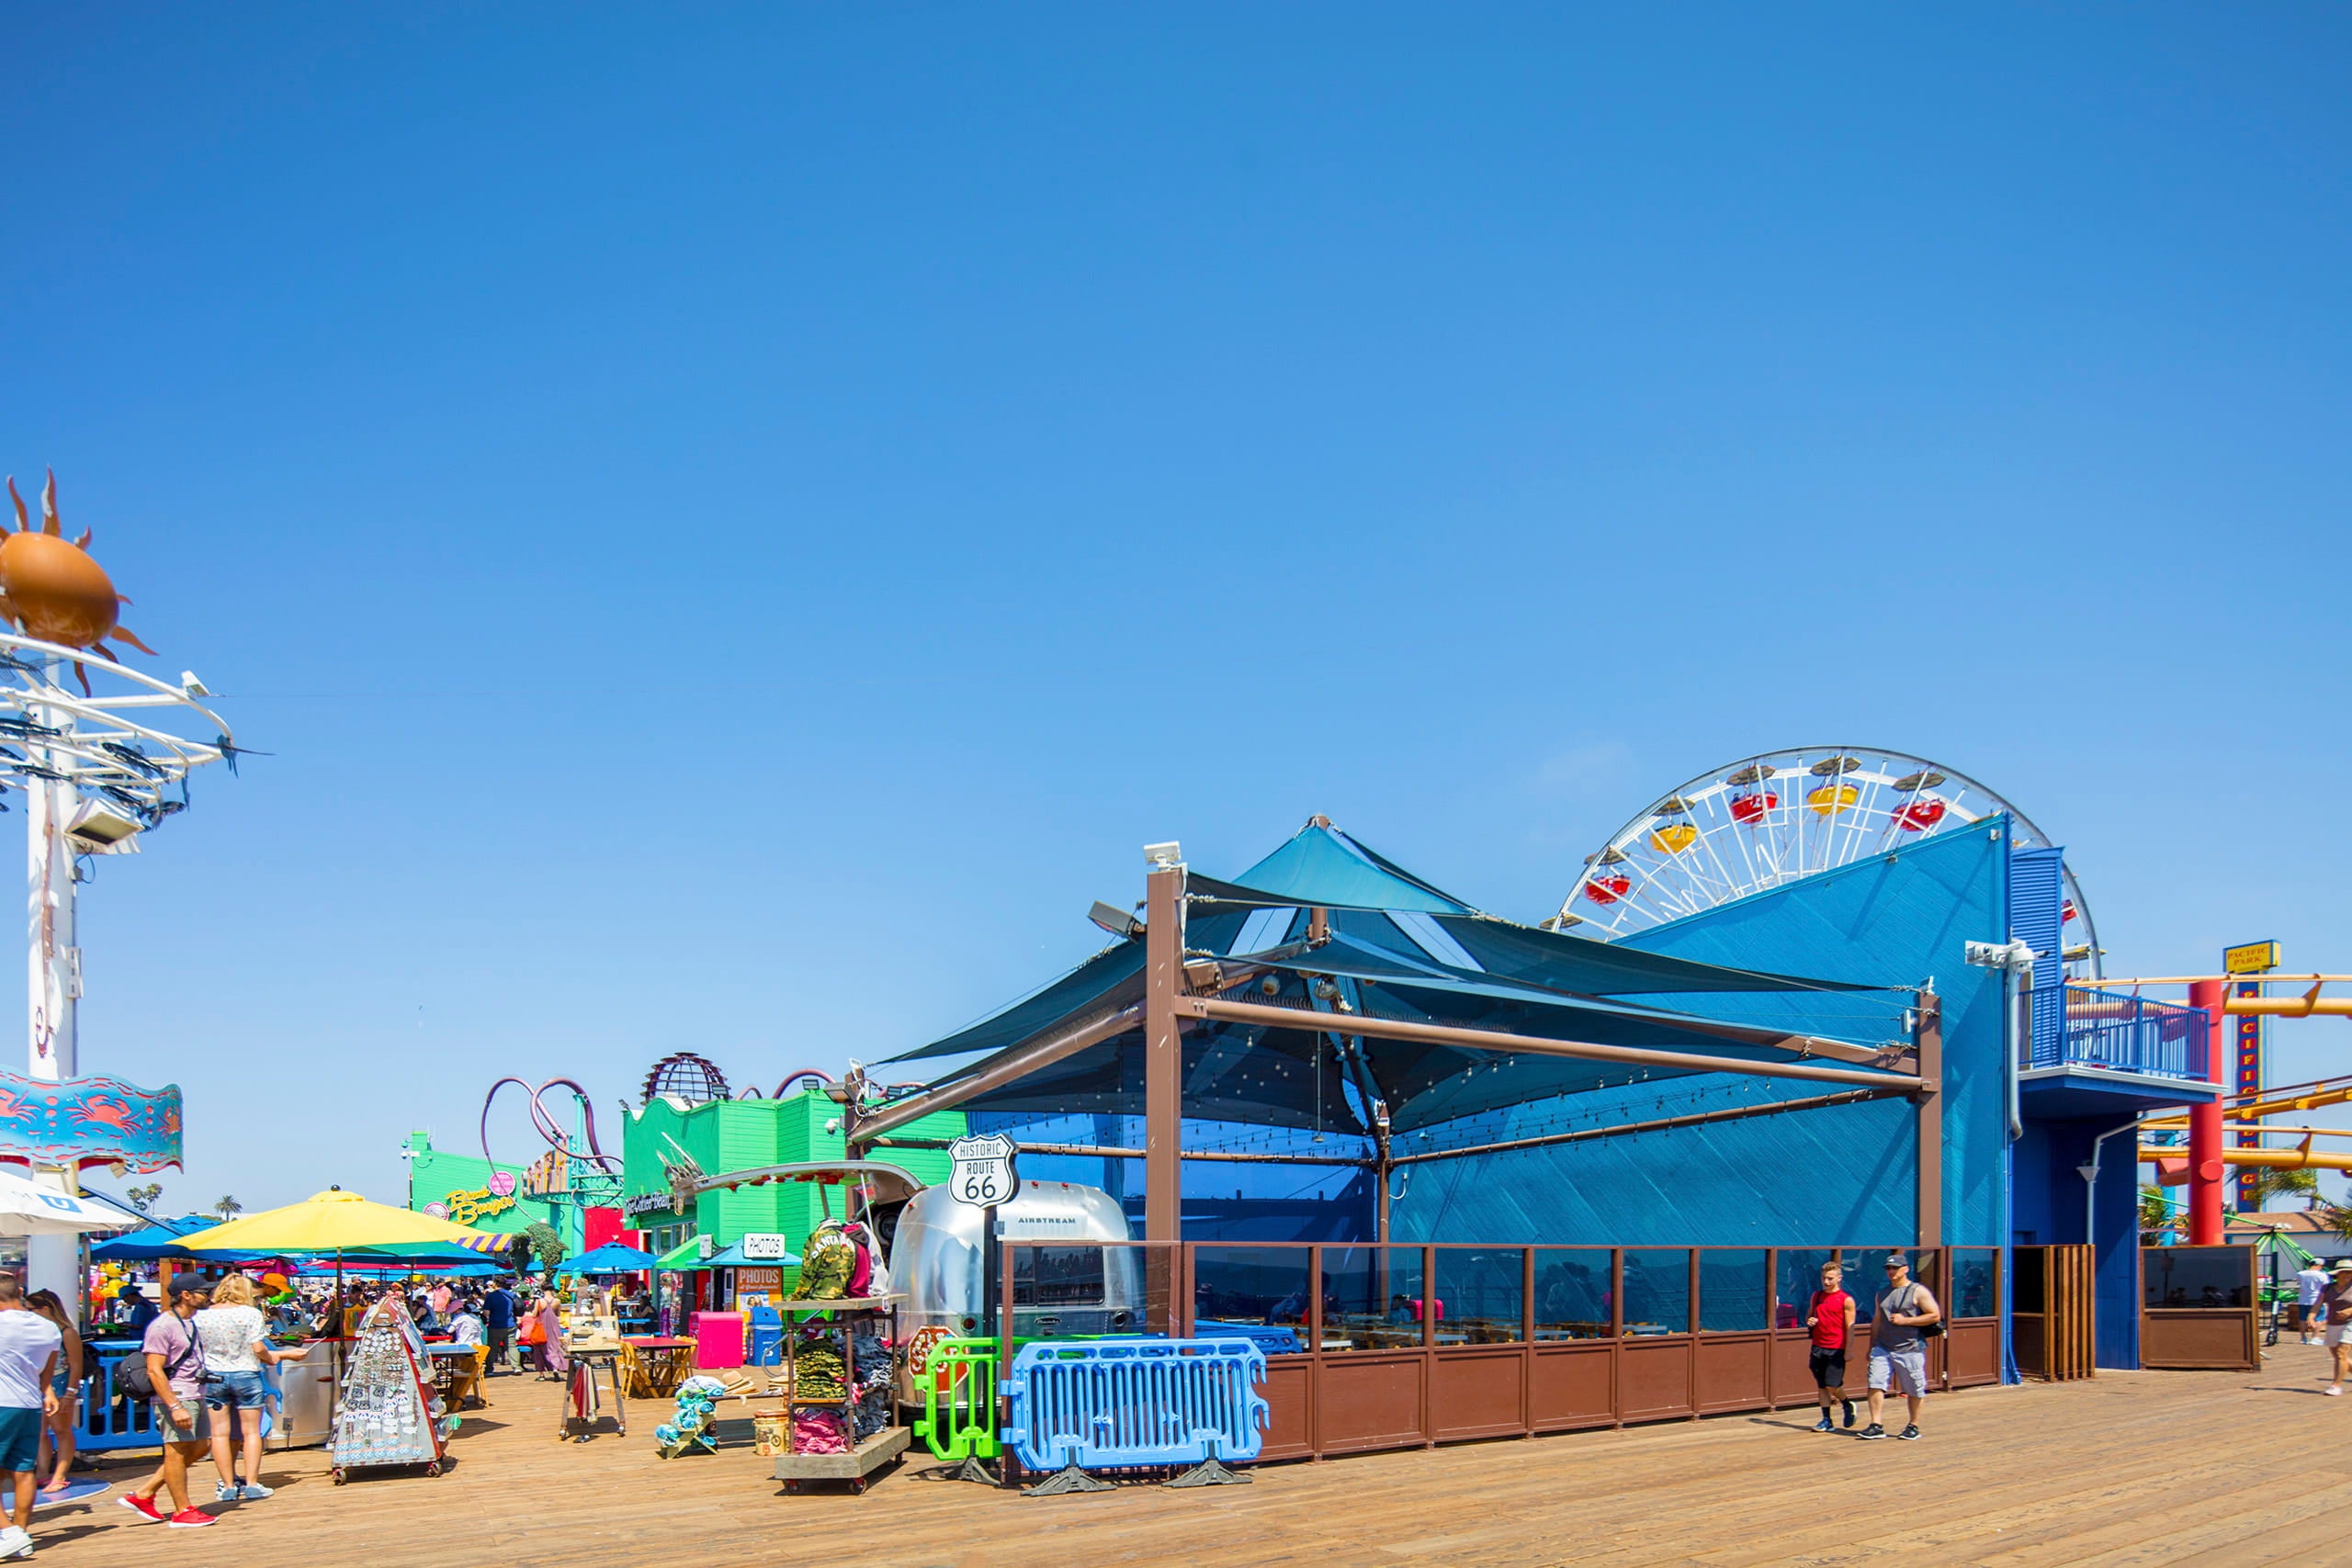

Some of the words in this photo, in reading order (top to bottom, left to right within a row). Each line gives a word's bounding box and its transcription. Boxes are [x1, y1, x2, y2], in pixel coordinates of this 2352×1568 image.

[2227, 947, 2267, 960] PACIFIC
[2233, 955, 2263, 966] PARK
[2242, 991, 2256, 1094] PCIFIC
[959, 1142, 1001, 1157] HISTORIC
[967, 1161, 995, 1175] ROUTE
[965, 1176, 996, 1200] 66
[749, 1236, 780, 1253] PHOTOS
[739, 1269, 779, 1284] PHOTOS
